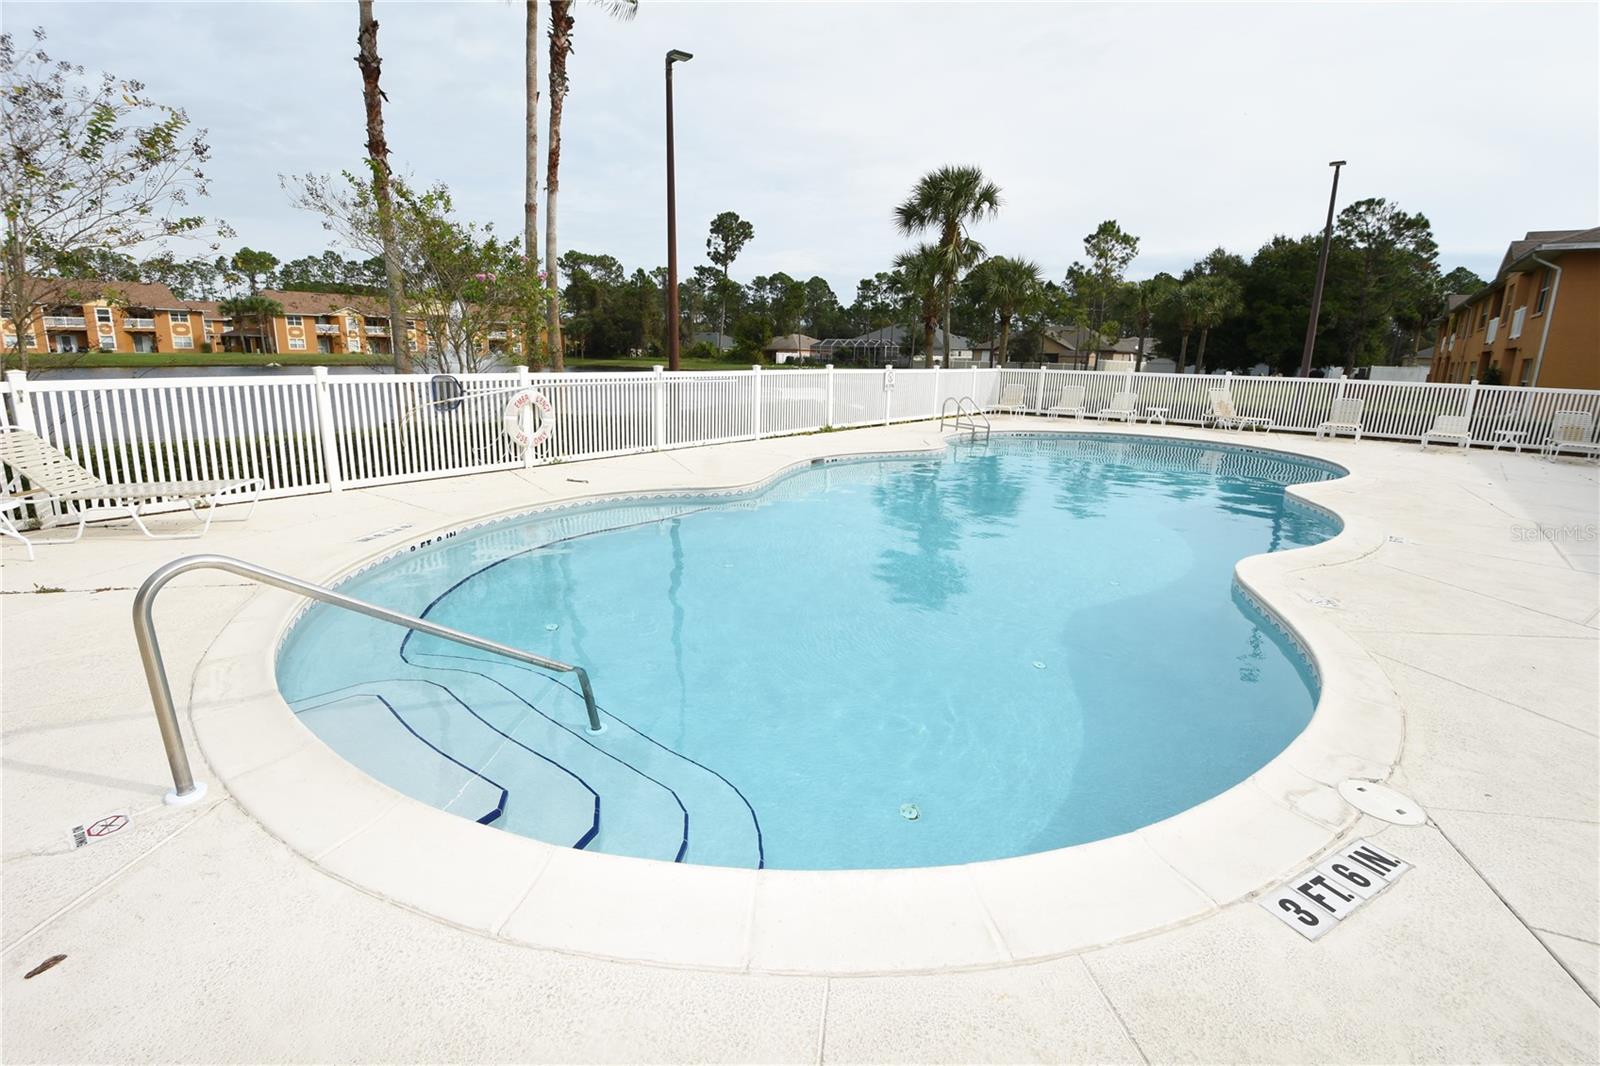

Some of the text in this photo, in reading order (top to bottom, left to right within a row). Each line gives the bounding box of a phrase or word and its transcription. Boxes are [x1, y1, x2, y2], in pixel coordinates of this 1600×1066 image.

[516, 431, 548, 445] USE ONLY
[1278, 845, 1402, 927] 3 FT. 6 IN.
